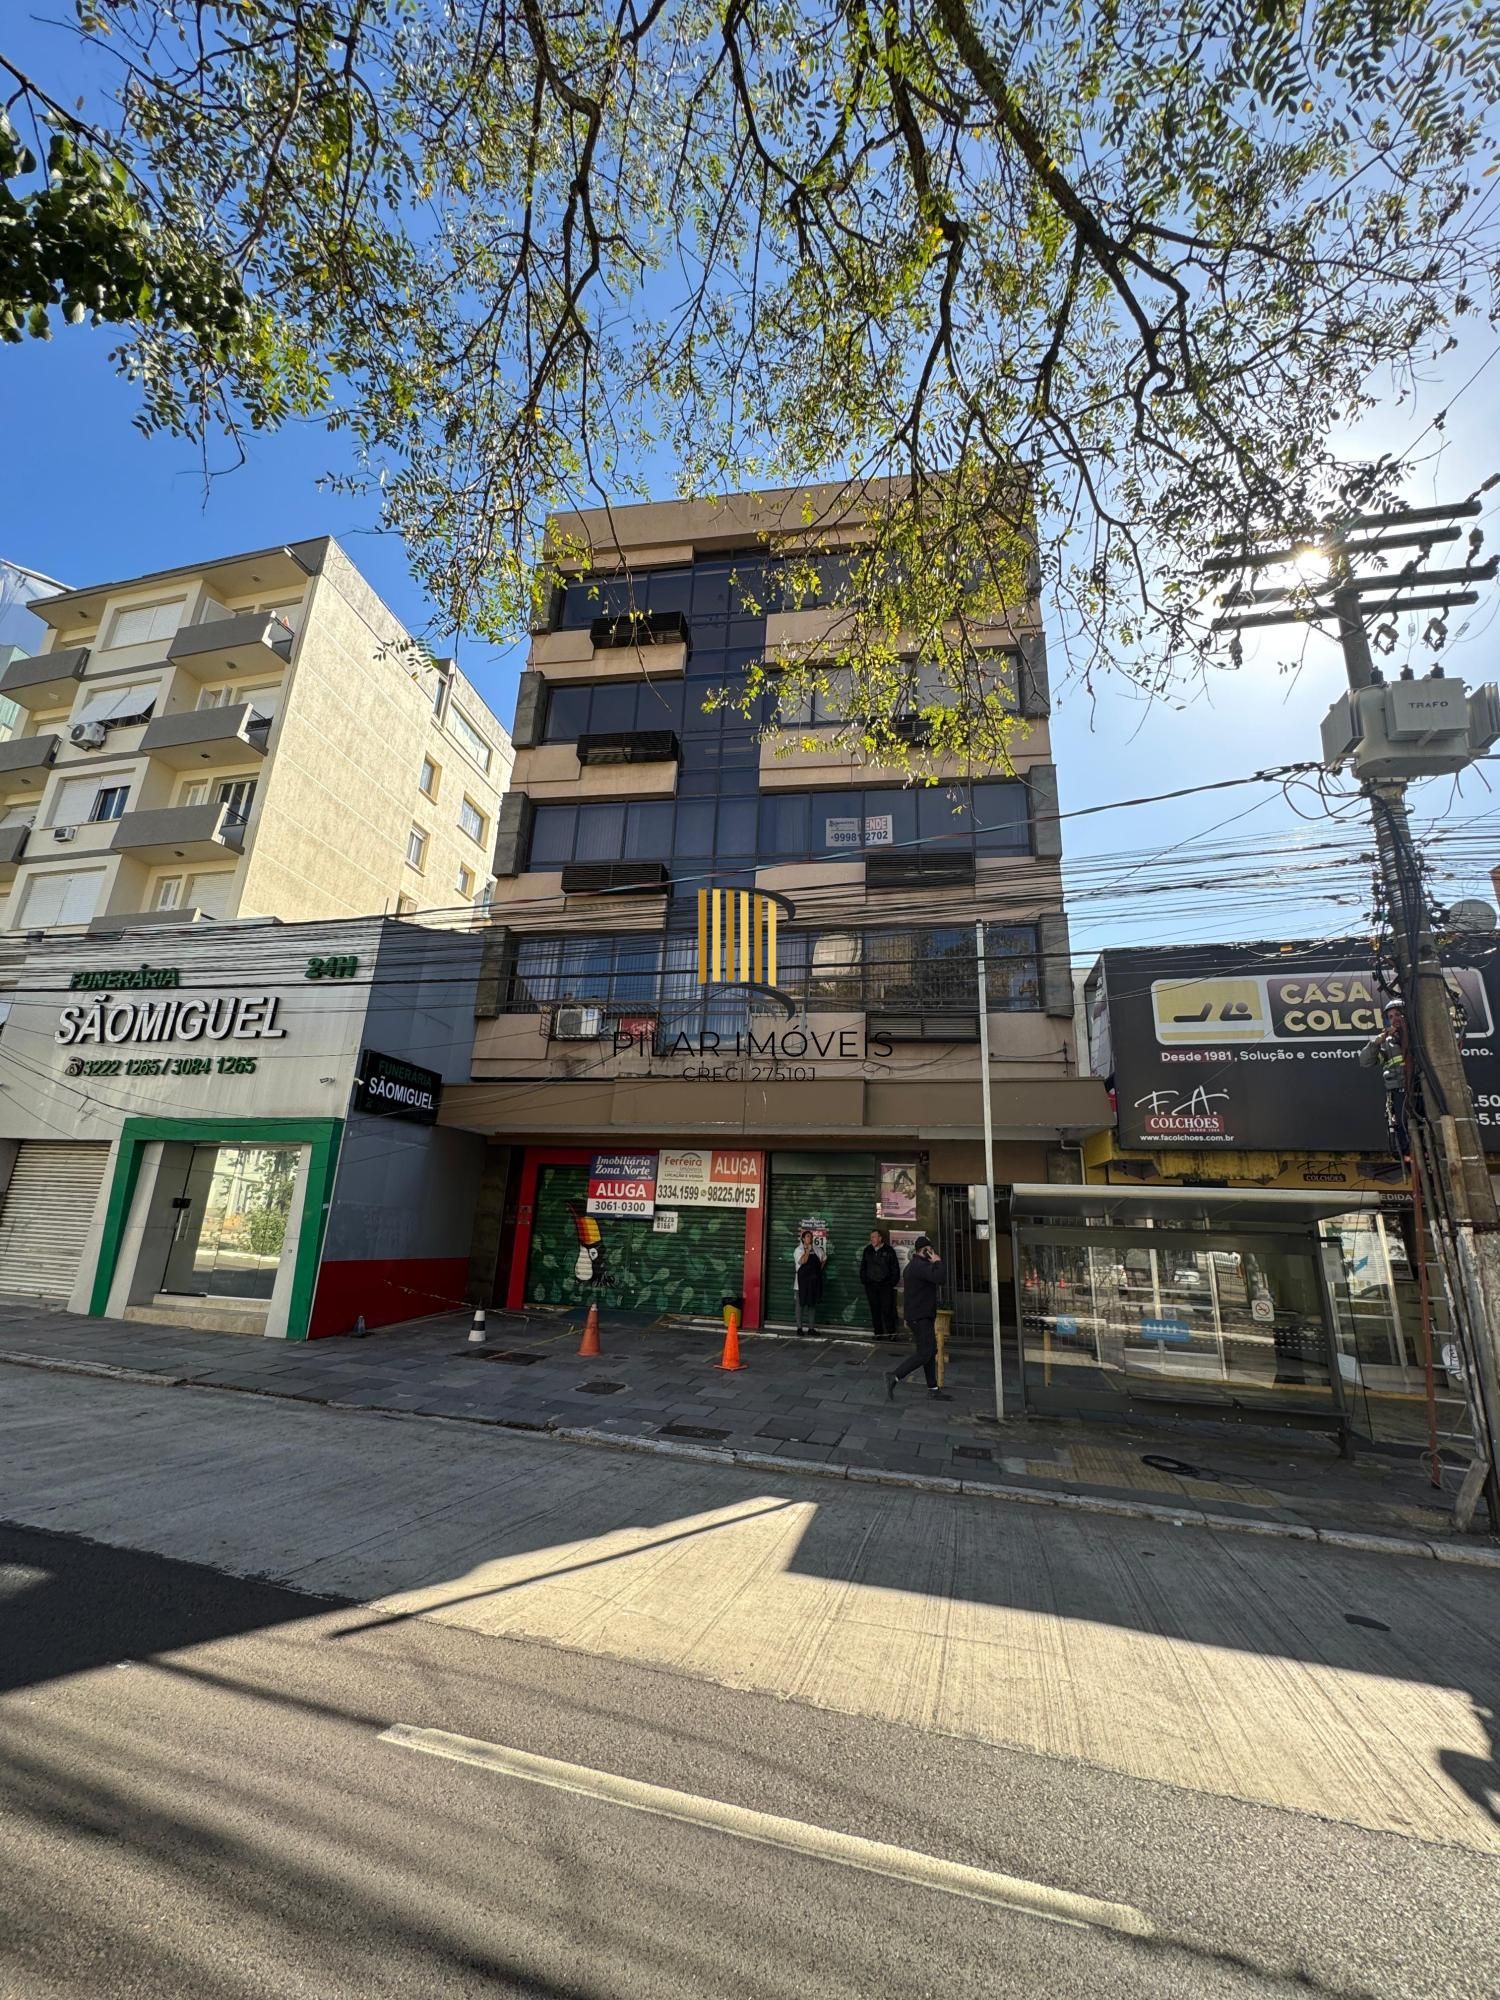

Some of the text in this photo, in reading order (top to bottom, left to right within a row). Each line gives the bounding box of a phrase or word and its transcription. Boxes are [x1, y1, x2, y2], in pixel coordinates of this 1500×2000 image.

[1408, 700, 1449, 709] TRAFO
[70, 956, 358, 990] FUNERÁRIA 24H
[1279, 981, 1374, 1005] CASA
[54, 994, 287, 1044] SÃOMIGUEL
[1161, 1051, 1202, 1062] Desde
[1240, 1049, 1294, 1063] Solução
[1311, 1049, 1363, 1059] confort
[1461, 1047, 1494, 1057] ono.
[83, 1059, 122, 1076] 3222
[216, 1056, 258, 1075] 1265
[369, 1075, 434, 1110] SÃOMIGUEL
[1150, 1115, 1220, 1129] COLCHÕES
[1140, 1134, 1235, 1142] www.facolchoes.com.br
[596, 1155, 651, 1167] Imobiliária
[664, 1156, 758, 1176] Ferreira ALUGA
[595, 1164, 651, 1176] Zona Norte
[595, 1182, 647, 1198] ALUGA
[657, 1184, 756, 1203] 3334.1599 98225.0155
[1380, 1193, 1416, 1201] EDIDA
[594, 1200, 646, 1212] 3061-0300
